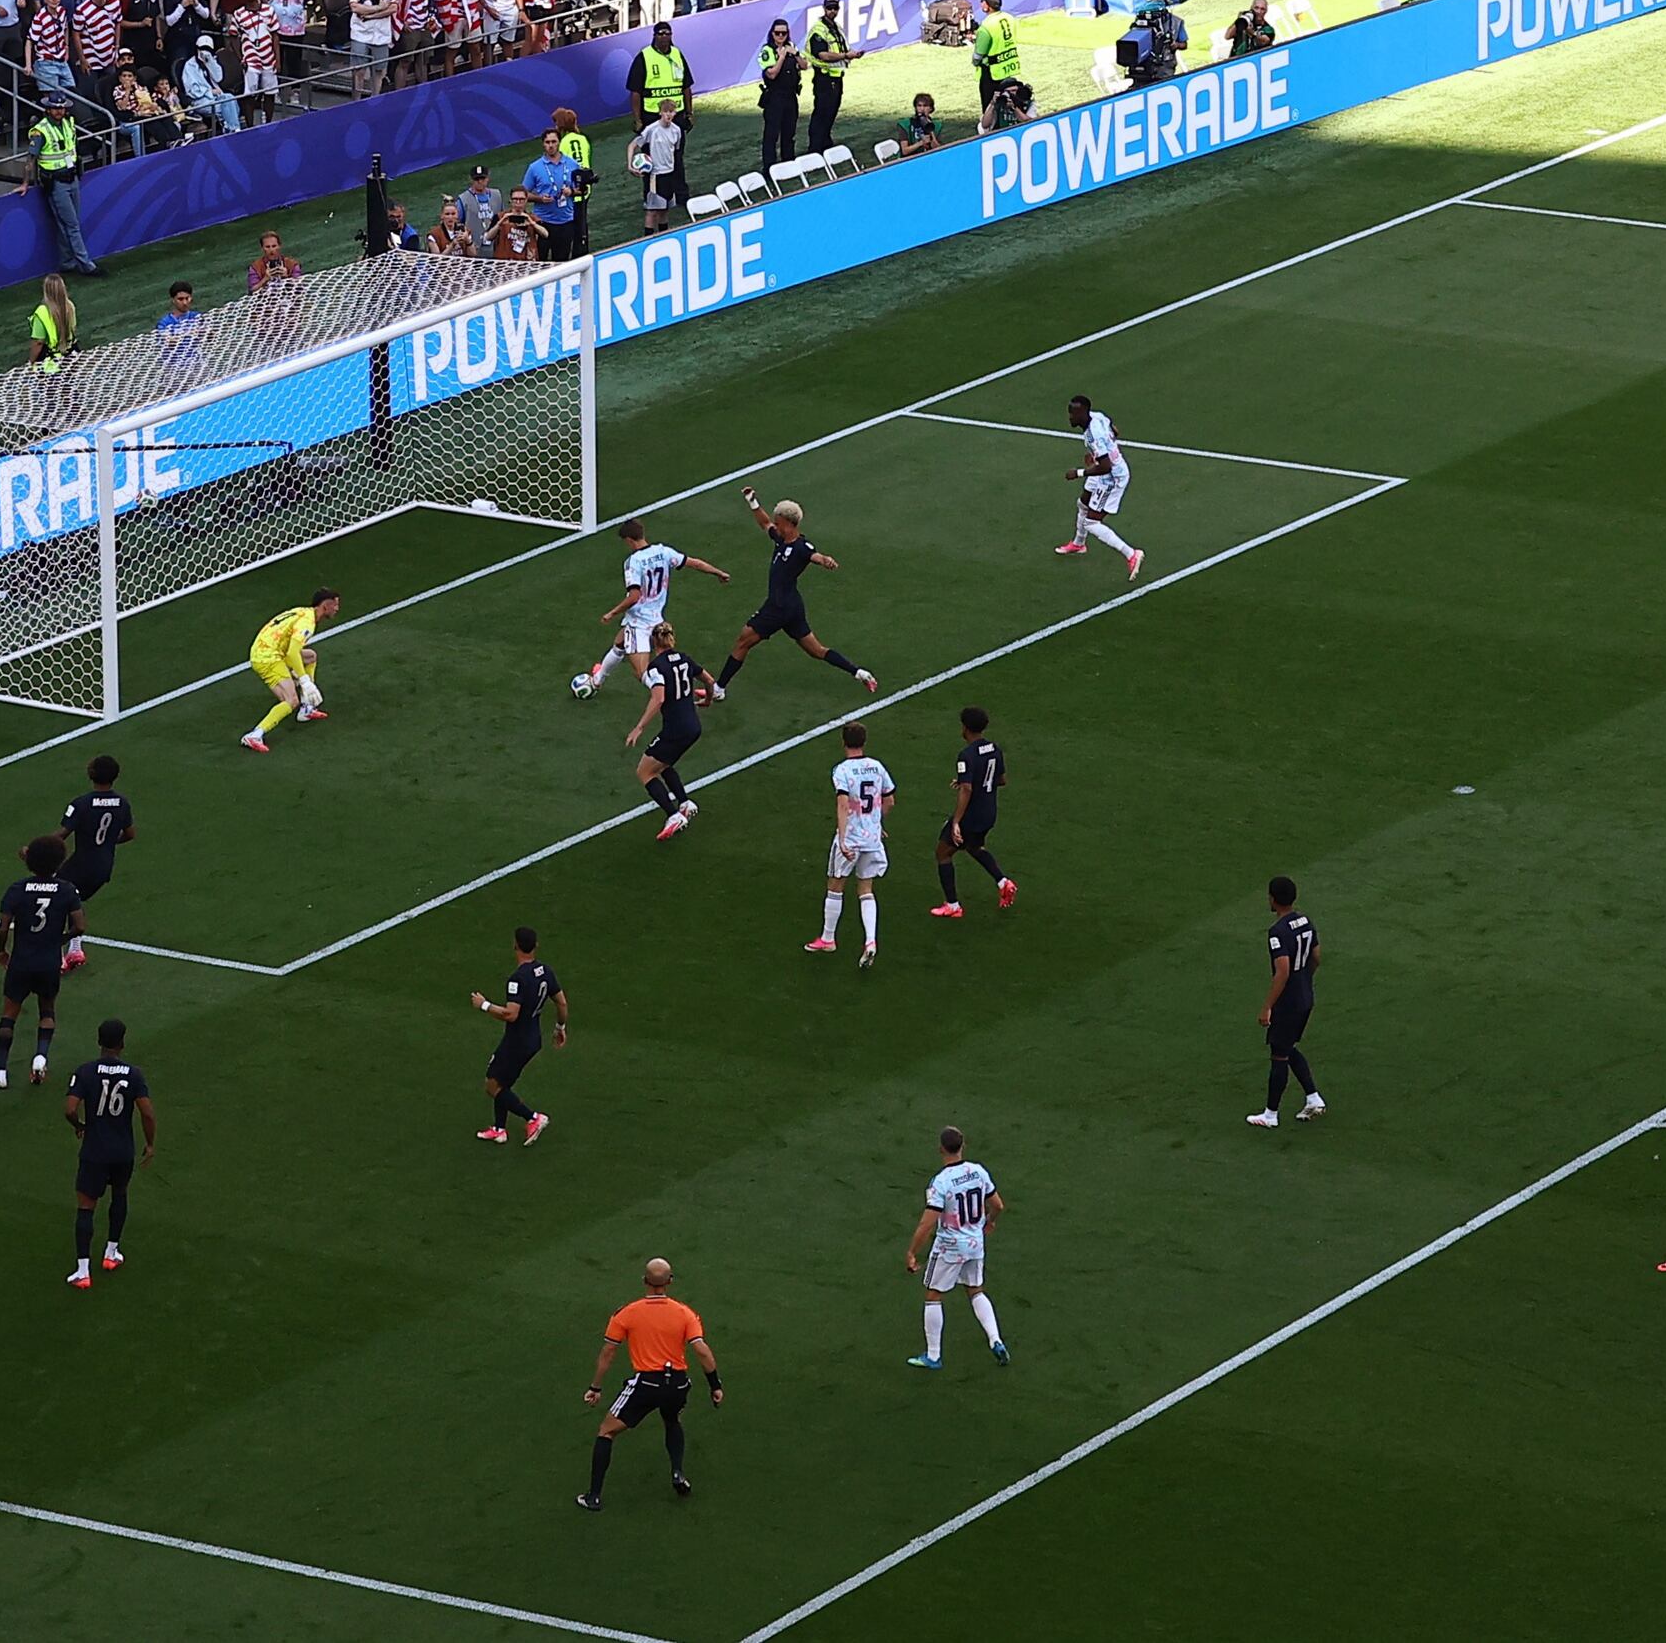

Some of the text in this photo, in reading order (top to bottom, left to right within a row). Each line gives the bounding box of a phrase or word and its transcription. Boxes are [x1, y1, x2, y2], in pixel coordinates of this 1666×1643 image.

[981, 48, 1292, 219] POWERADE
[414, 211, 766, 402] POWERADE
[643, 566, 664, 598] 17
[672, 662, 690, 700] 13
[982, 758, 996, 794] 4
[860, 780, 875, 814] 5
[95, 811, 113, 846] 8
[25, 882, 59, 893] RICHARDS
[30, 897, 52, 933] 3
[1293, 930, 1313, 971] 17
[532, 979, 550, 1018] 2
[96, 1078, 129, 1118] 16
[958, 1188, 984, 1226] 10
